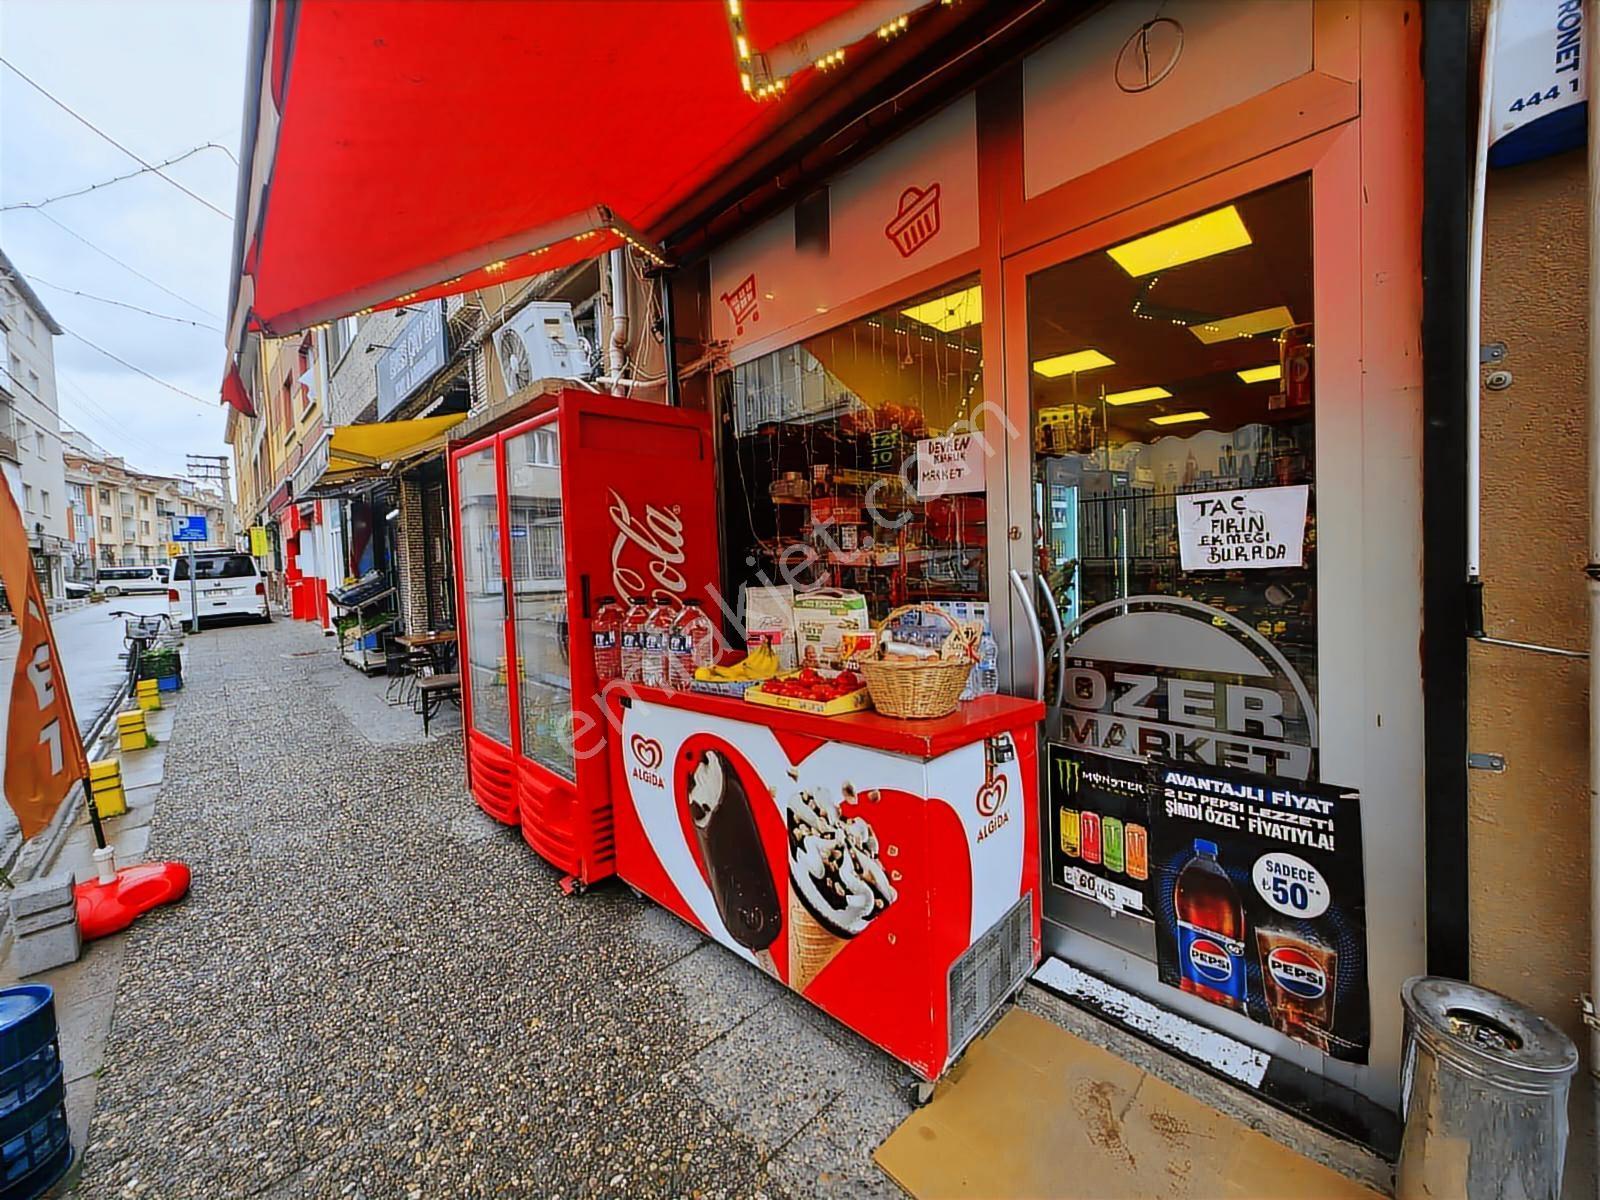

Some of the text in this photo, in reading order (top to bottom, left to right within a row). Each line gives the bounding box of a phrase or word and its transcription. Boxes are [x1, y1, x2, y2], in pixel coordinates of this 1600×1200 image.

[1509, 85, 1560, 112] 444
[1193, 496, 1246, 516] TAÇ
[172, 518, 190, 536] P
[1211, 515, 1265, 534] FIRIN
[1206, 544, 1286, 564] BURADA
[1063, 659, 1284, 739] ÖZER
[1060, 713, 1292, 777] MARKET
[632, 767, 665, 790] ALGIDA
[1082, 771, 1145, 794] MONSTER
[1164, 788, 1176, 798] 2
[1177, 790, 1198, 802] LT
[1200, 794, 1245, 813] PEPSI
[1165, 772, 1265, 802] AVANTAJLI
[1271, 790, 1334, 815] FİYAT
[976, 811, 1009, 843] ALGIDA
[1248, 817, 1336, 852] FİYATIYLA!
[1079, 874, 1096, 891] 60
[1265, 859, 1316, 884] SADECE
[1191, 949, 1231, 971] PEPSI
[1271, 960, 1324, 986] PEPSI
